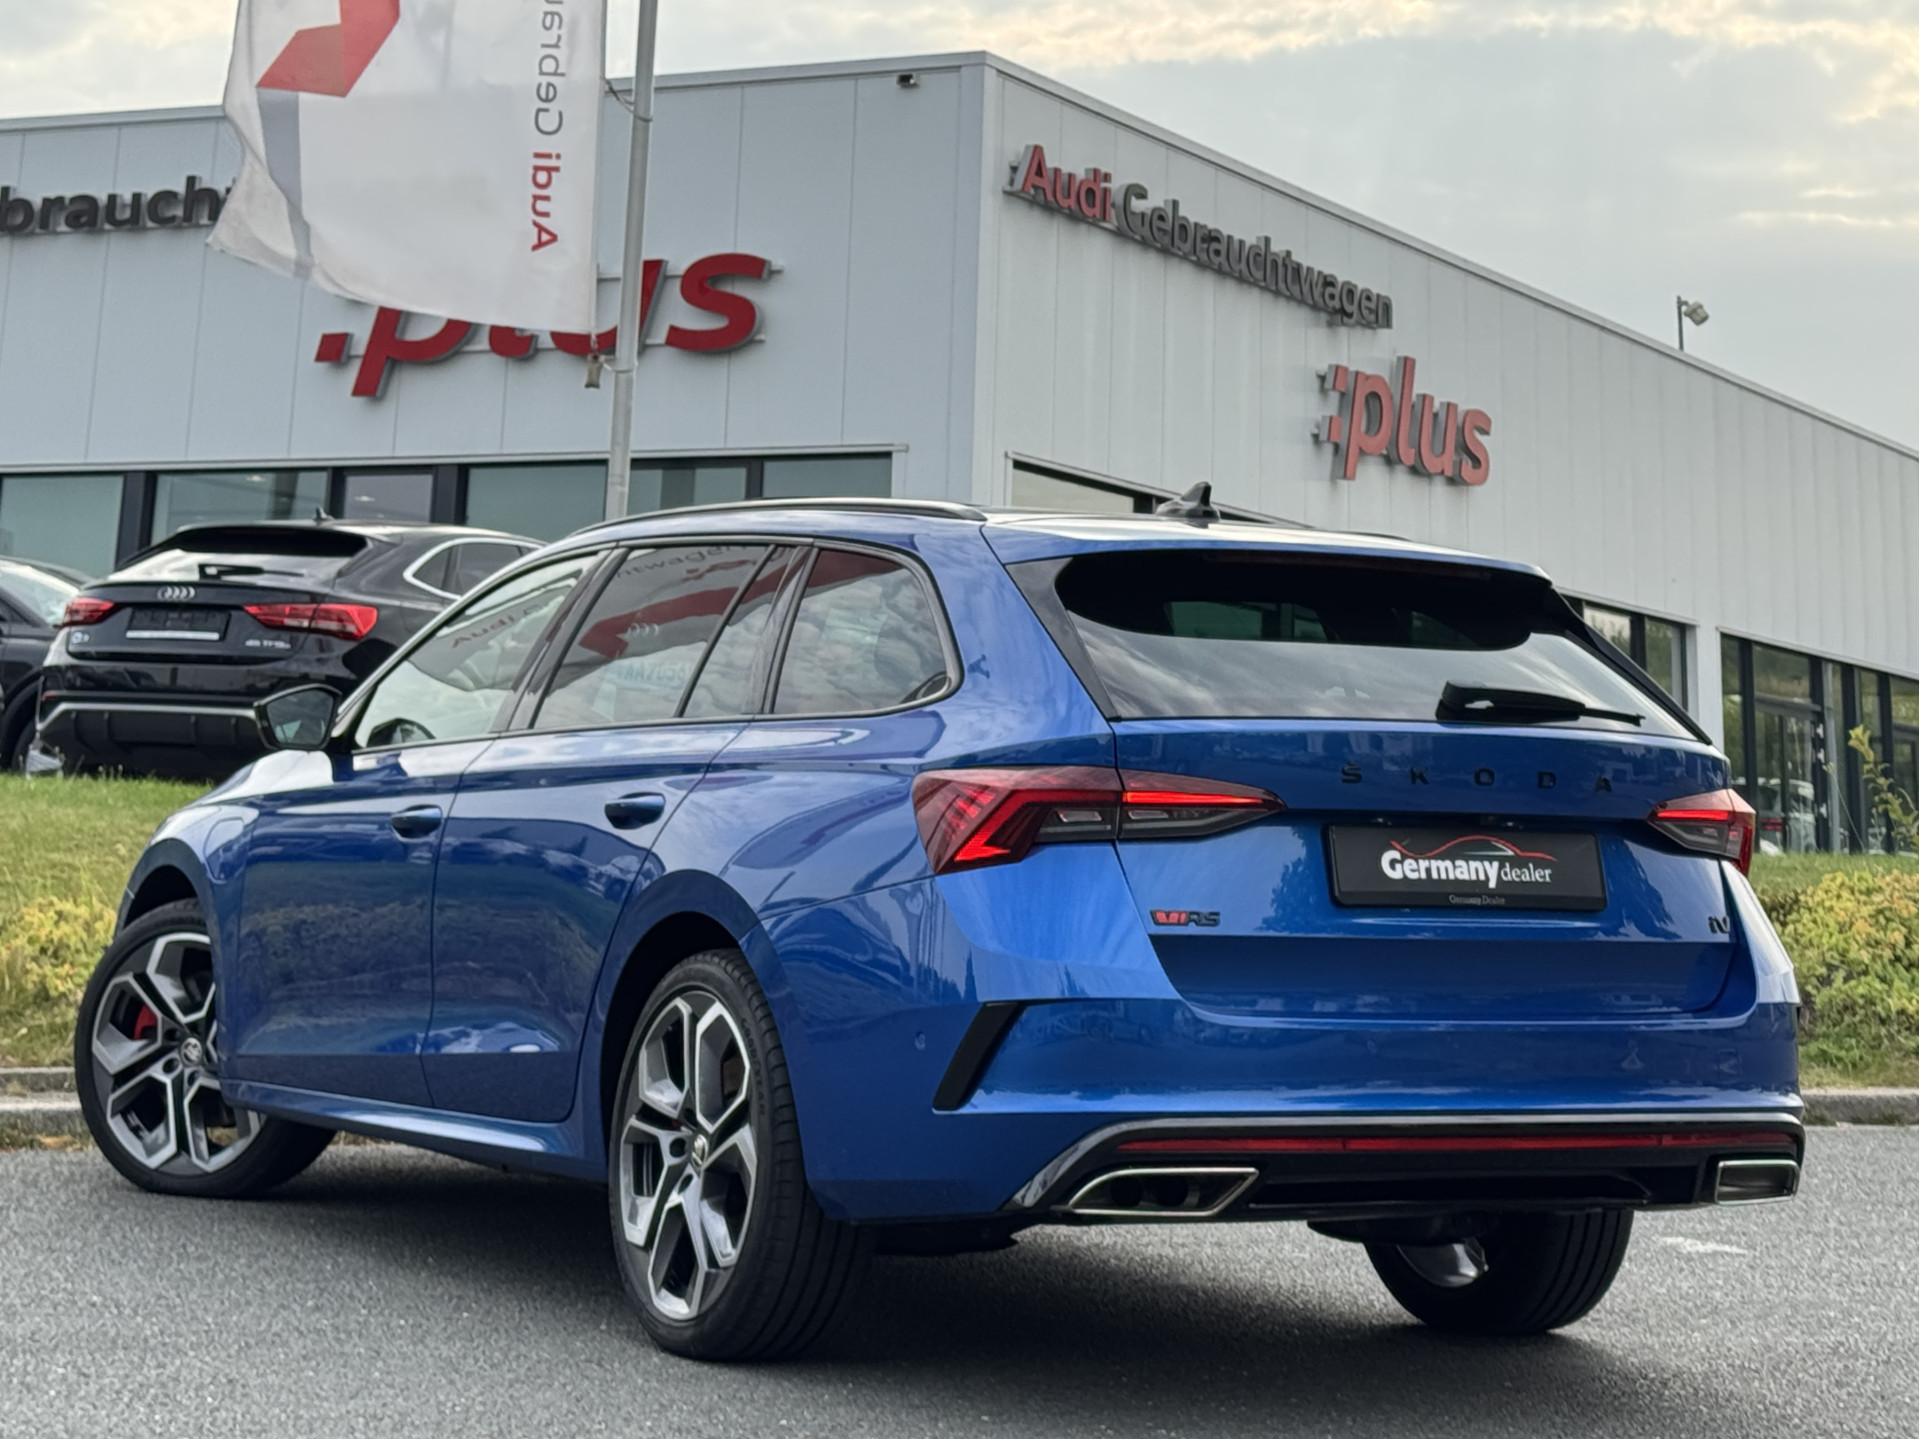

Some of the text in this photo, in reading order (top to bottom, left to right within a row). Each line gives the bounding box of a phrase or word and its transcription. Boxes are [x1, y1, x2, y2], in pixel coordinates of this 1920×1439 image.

[0, 175, 234, 232] brauch
[1020, 144, 1394, 329] Audi Gebrauchtwagen
[1381, 849, 1552, 888] Germany dealer
